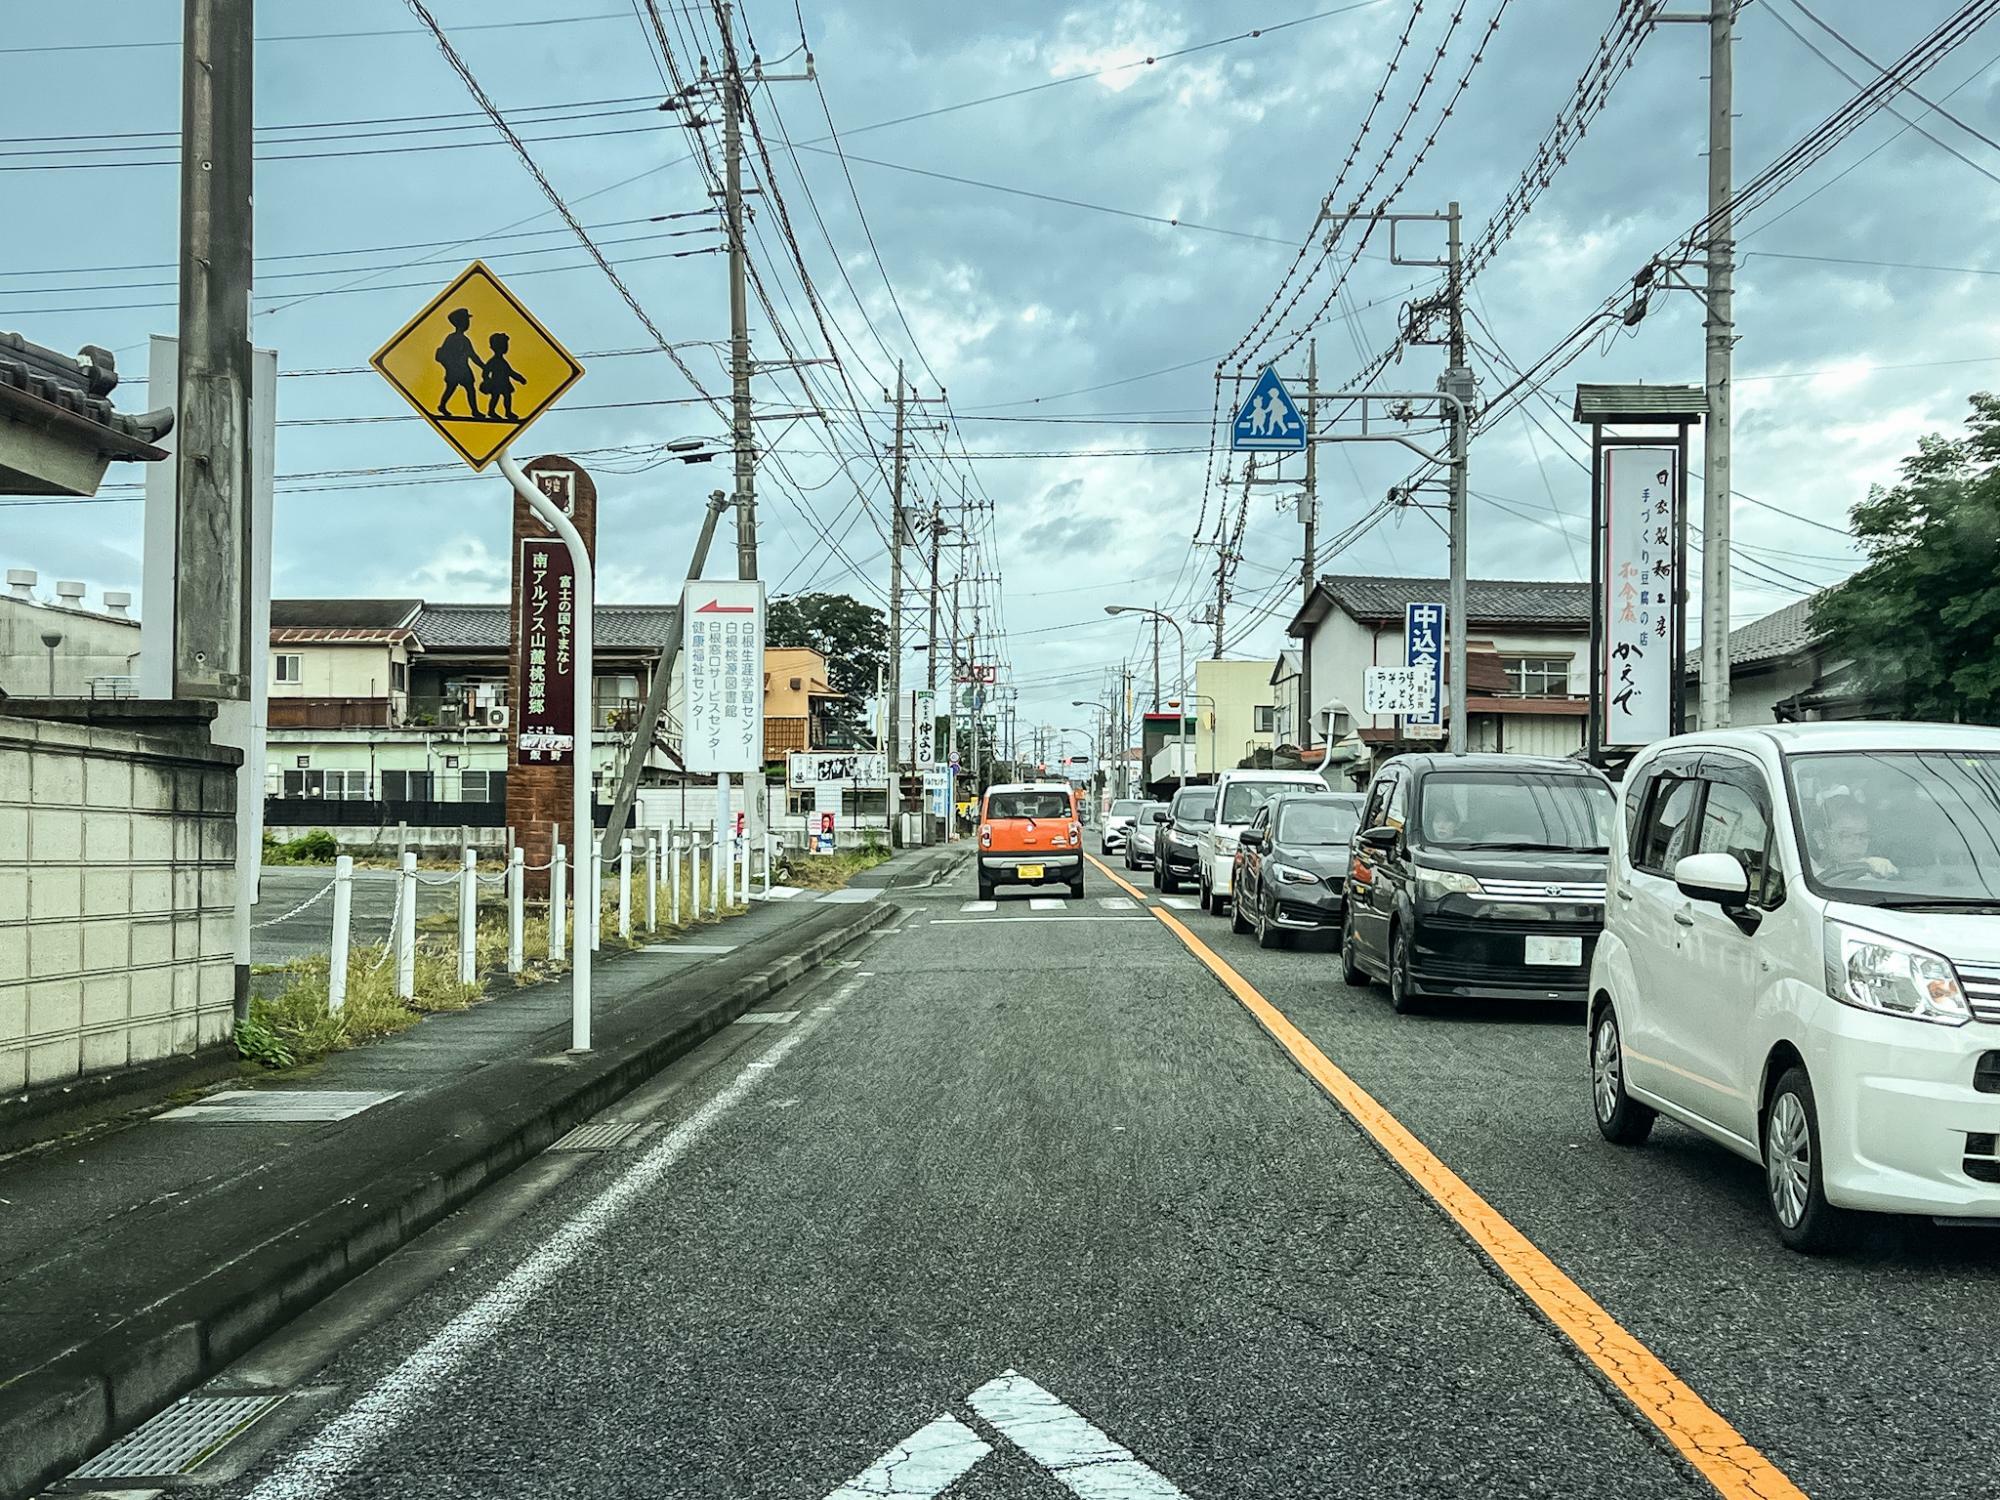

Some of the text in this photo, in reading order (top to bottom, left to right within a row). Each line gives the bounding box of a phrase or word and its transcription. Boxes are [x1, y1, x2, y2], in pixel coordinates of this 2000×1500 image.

[1640, 488, 1650, 647] 手づくり豆腐の店
[528, 552, 548, 715] 南アルプス山麓桃源郷
[556, 575, 572, 675] 富士の国やまなし
[692, 621, 705, 731] 健康福祉センター
[725, 622, 738, 718] 白根桃源図書館
[1612, 641, 1644, 716] かえで
[709, 621, 721, 760] 白根窓口サービスセンター
[742, 621, 754, 759] 白根生涯学習センター
[1378, 672, 1386, 709] ラーメン
